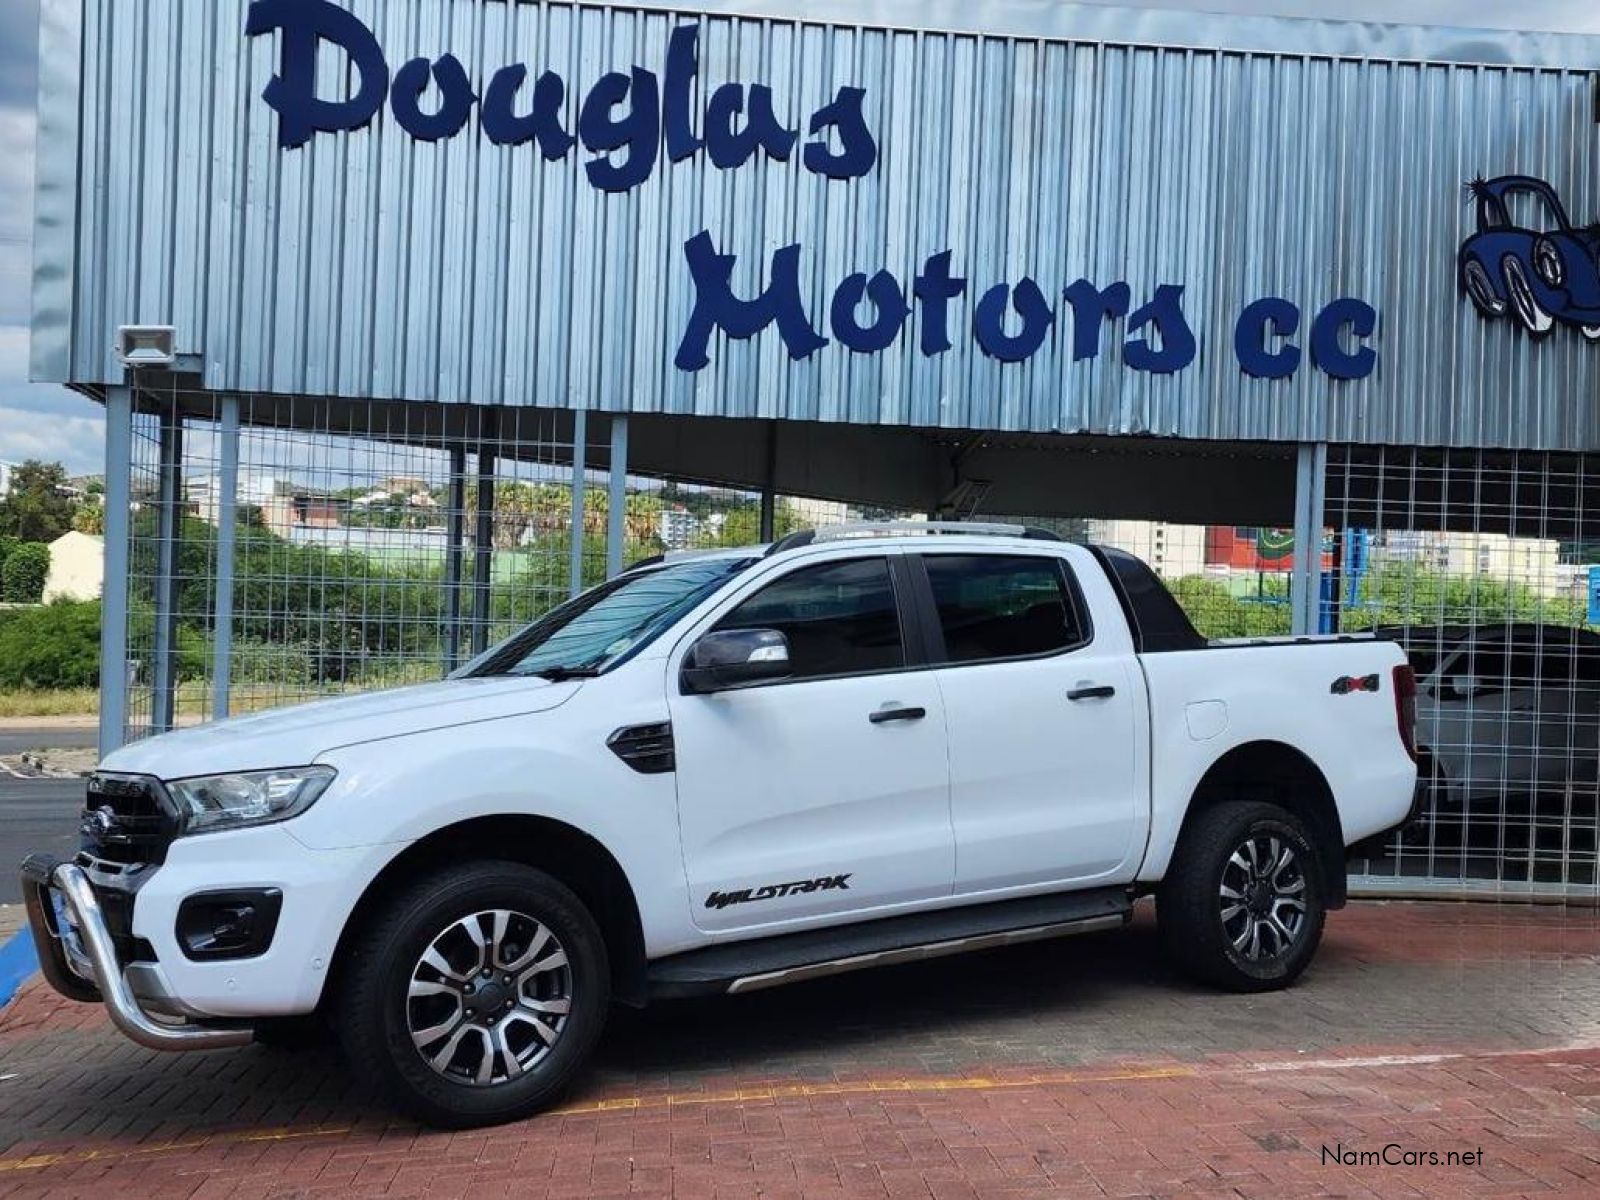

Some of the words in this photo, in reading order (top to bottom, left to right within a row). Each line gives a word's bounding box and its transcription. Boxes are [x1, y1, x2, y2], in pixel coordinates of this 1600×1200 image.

[245, 0, 877, 193] Douglas
[675, 230, 1197, 374] Motors
[1235, 297, 1379, 379] cc
[704, 873, 853, 909] WILDTRAK
